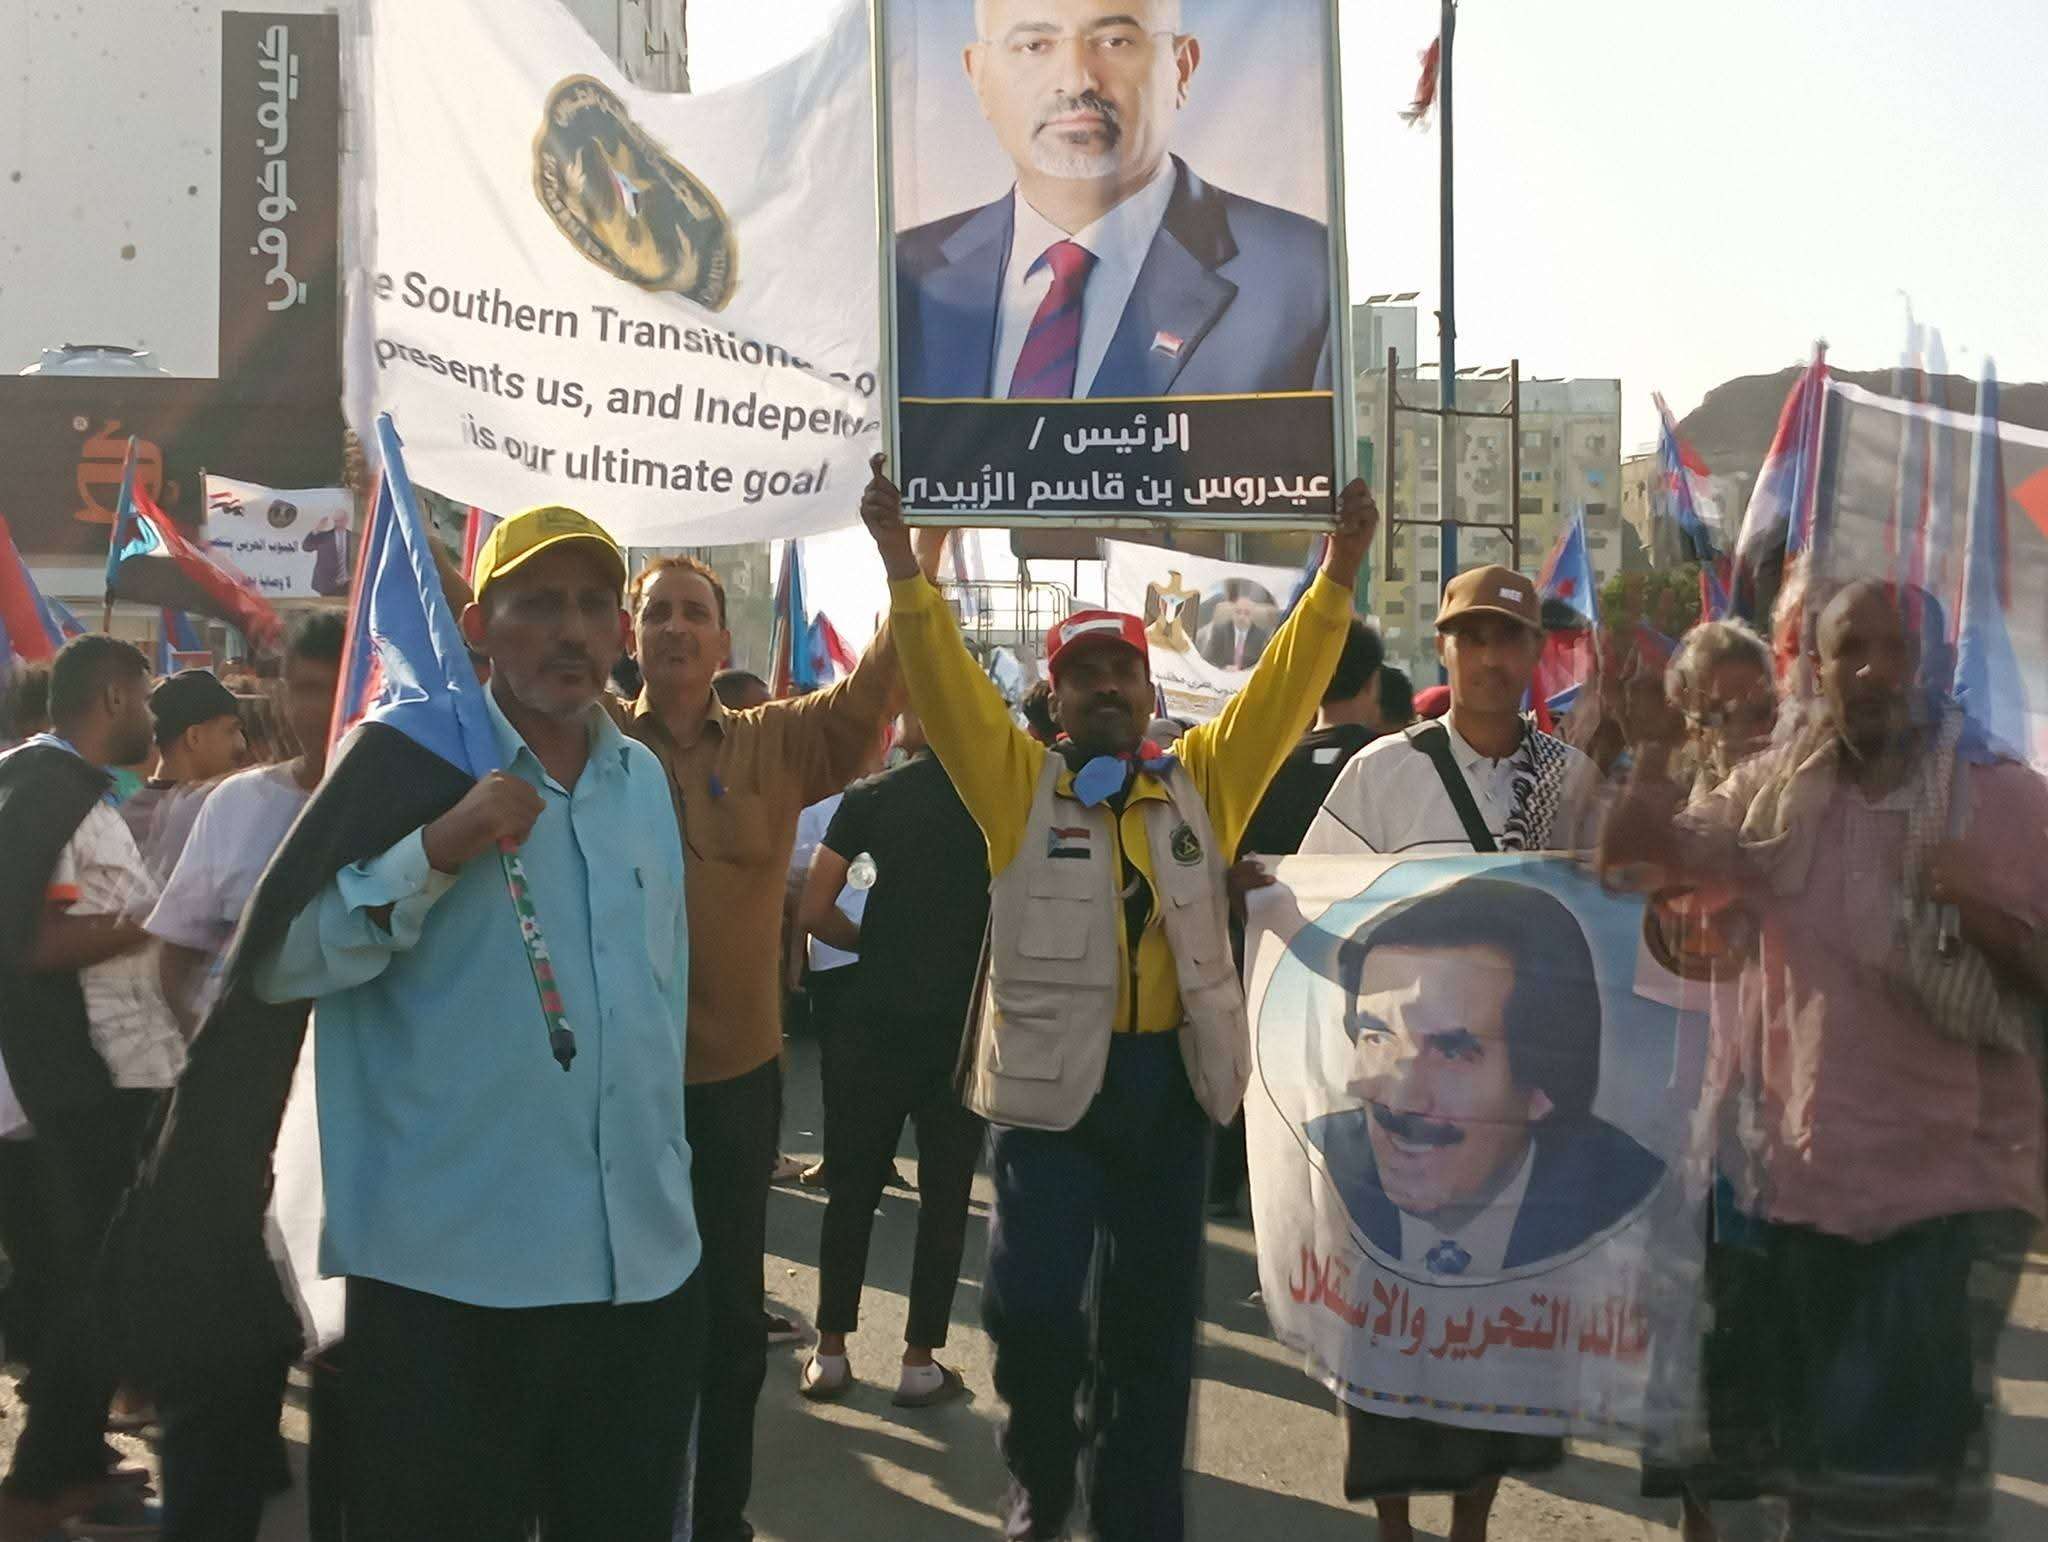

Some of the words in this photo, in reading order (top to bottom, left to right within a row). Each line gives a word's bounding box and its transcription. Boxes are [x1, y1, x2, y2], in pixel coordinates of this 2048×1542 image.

[249, 158, 308, 311] كوفي
[401, 271, 579, 339] Southern
[374, 337, 525, 400] presents
[536, 375, 595, 418] us,
[606, 384, 684, 420] and
[466, 412, 498, 451] is
[504, 434, 556, 473] our
[565, 444, 734, 494] ultimate
[742, 460, 830, 504] goal
[1063, 412, 1190, 455] الرئيس
[1026, 470, 1125, 509] قاسم
[1135, 474, 1173, 508] بن
[1184, 474, 1331, 507] عيدروس
[1426, 1293, 1571, 1361] التحرير
